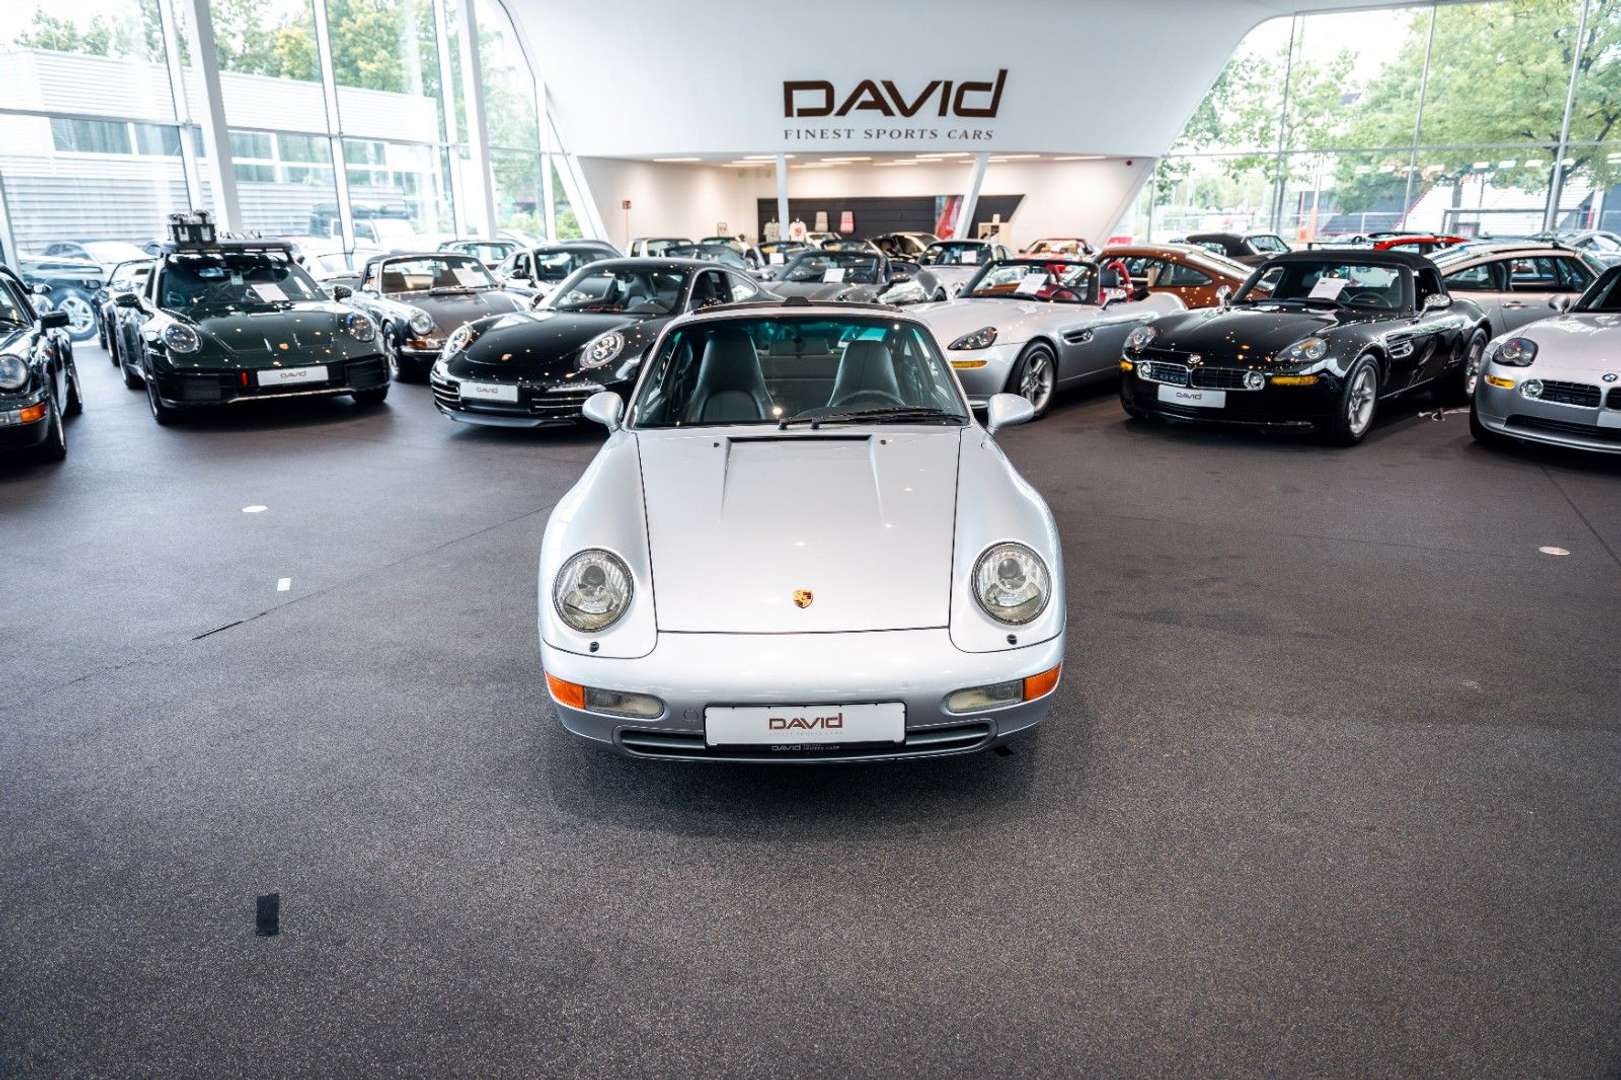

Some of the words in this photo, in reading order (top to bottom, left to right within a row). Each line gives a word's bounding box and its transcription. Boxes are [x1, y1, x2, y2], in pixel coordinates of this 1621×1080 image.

[784, 128, 855, 141] FINEST
[864, 128, 939, 140] SPORTS
[947, 128, 994, 140] CARS
